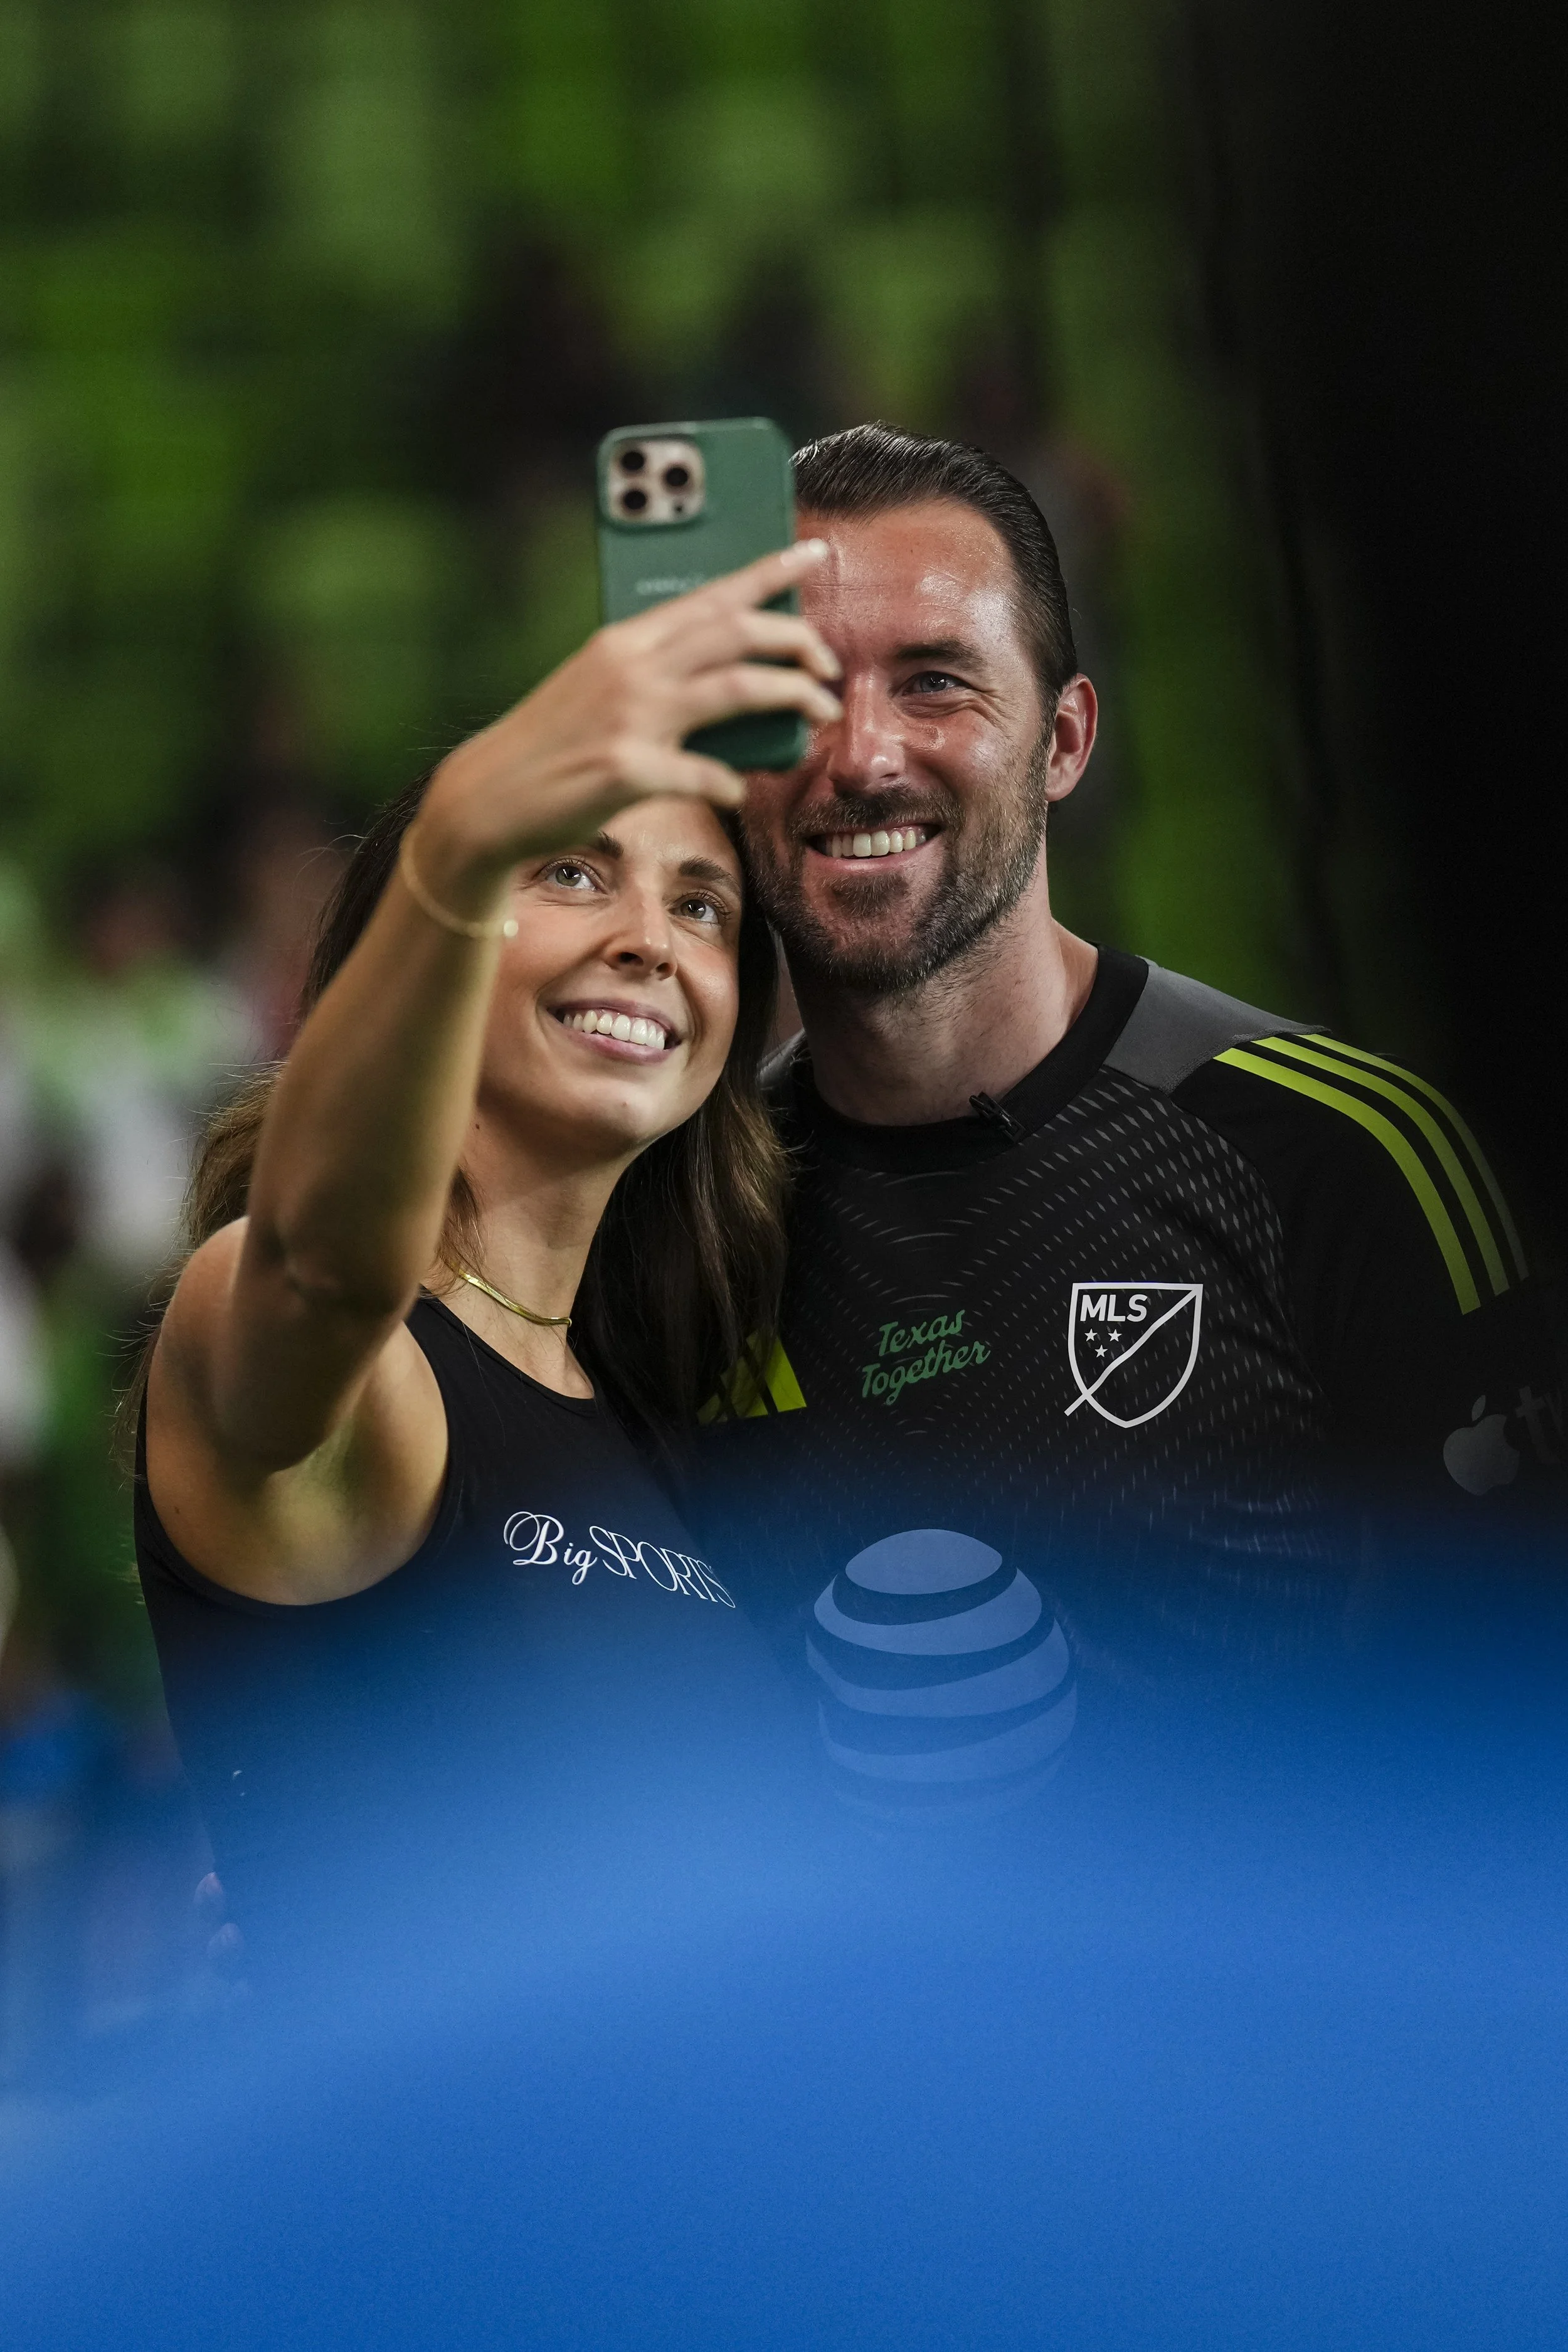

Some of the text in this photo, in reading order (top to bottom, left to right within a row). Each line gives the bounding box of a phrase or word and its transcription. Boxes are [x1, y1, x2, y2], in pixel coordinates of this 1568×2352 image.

[1079, 1293, 1148, 1322] MLS
[879, 1309, 965, 1357] Texas
[862, 1339, 991, 1406] Together
